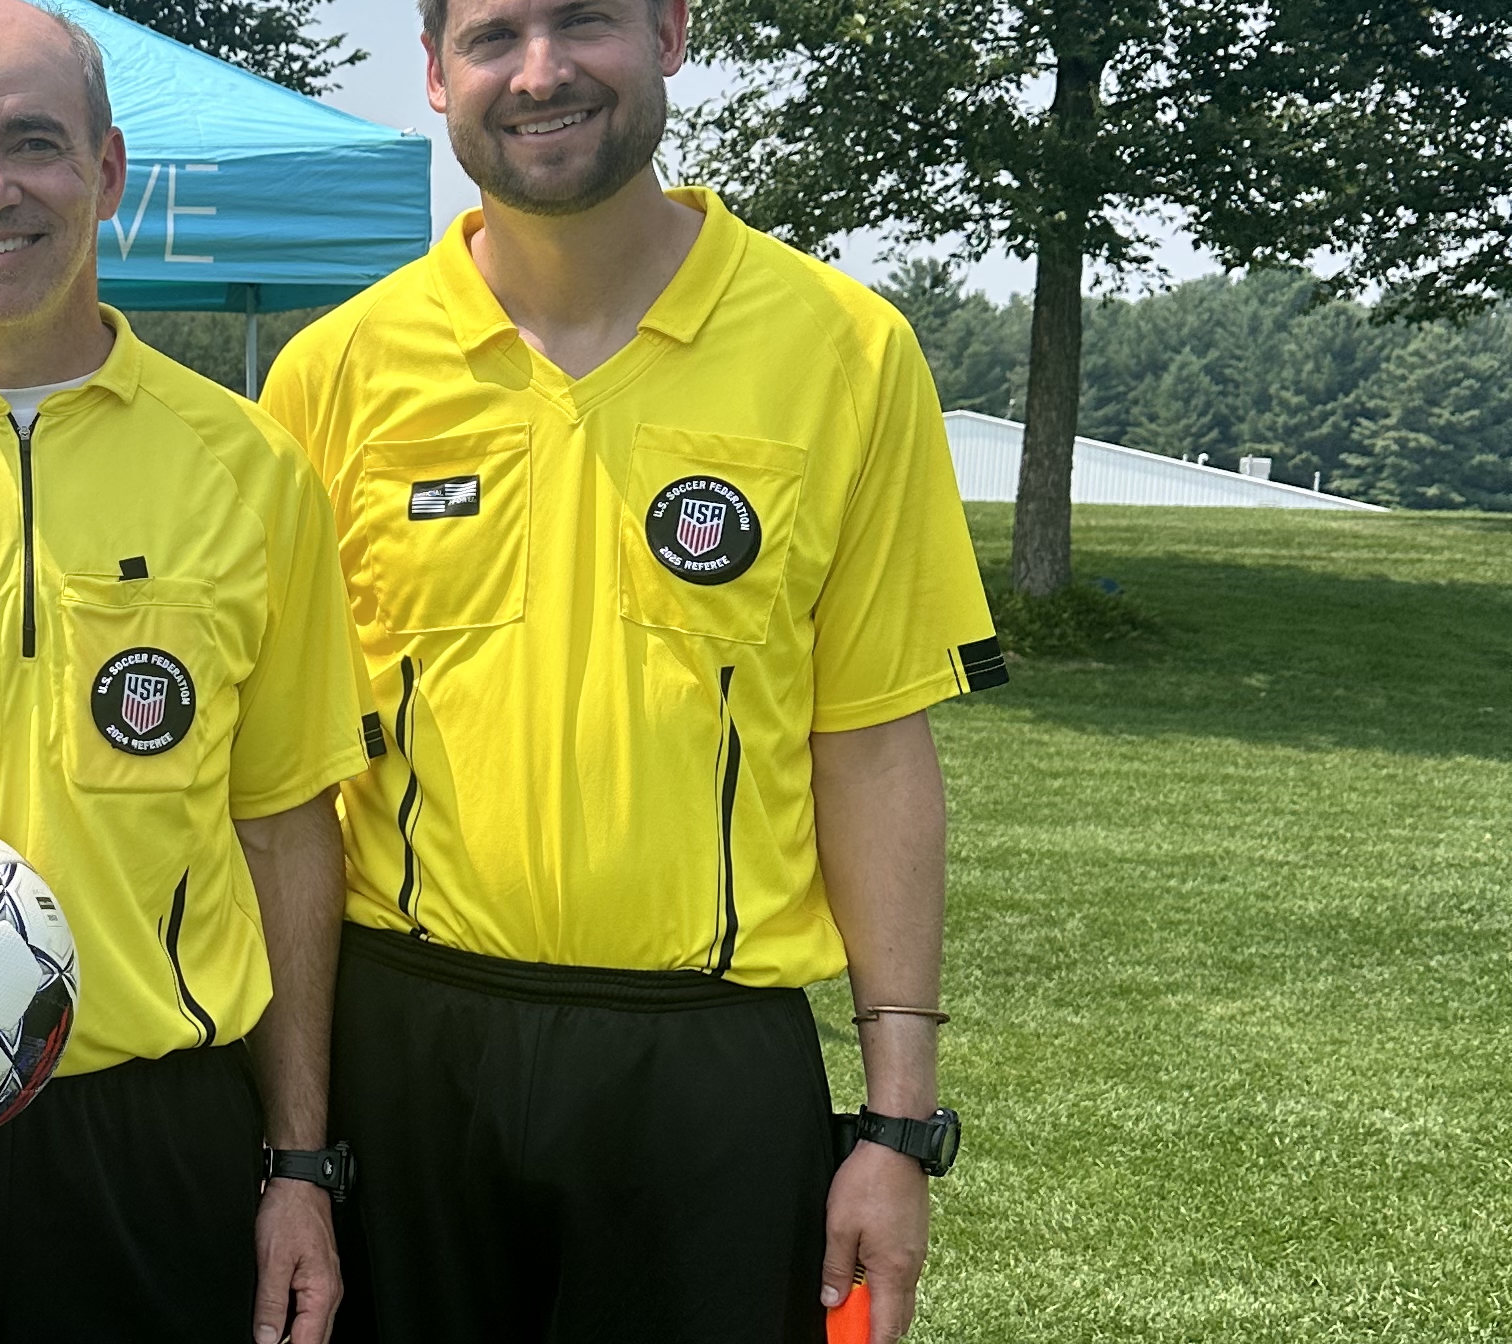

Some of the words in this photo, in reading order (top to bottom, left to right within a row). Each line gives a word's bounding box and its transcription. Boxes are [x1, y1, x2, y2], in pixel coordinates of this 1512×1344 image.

[666, 480, 707, 501] SOCCER
[709, 481, 750, 531] FEDERATION
[682, 500, 725, 525] USA
[659, 546, 683, 566] 2025
[684, 555, 730, 571] REFEREE
[109, 653, 148, 676] SOCCER
[151, 654, 190, 705] FEDERATION
[127, 676, 165, 701] USA
[106, 724, 130, 746] 2024
